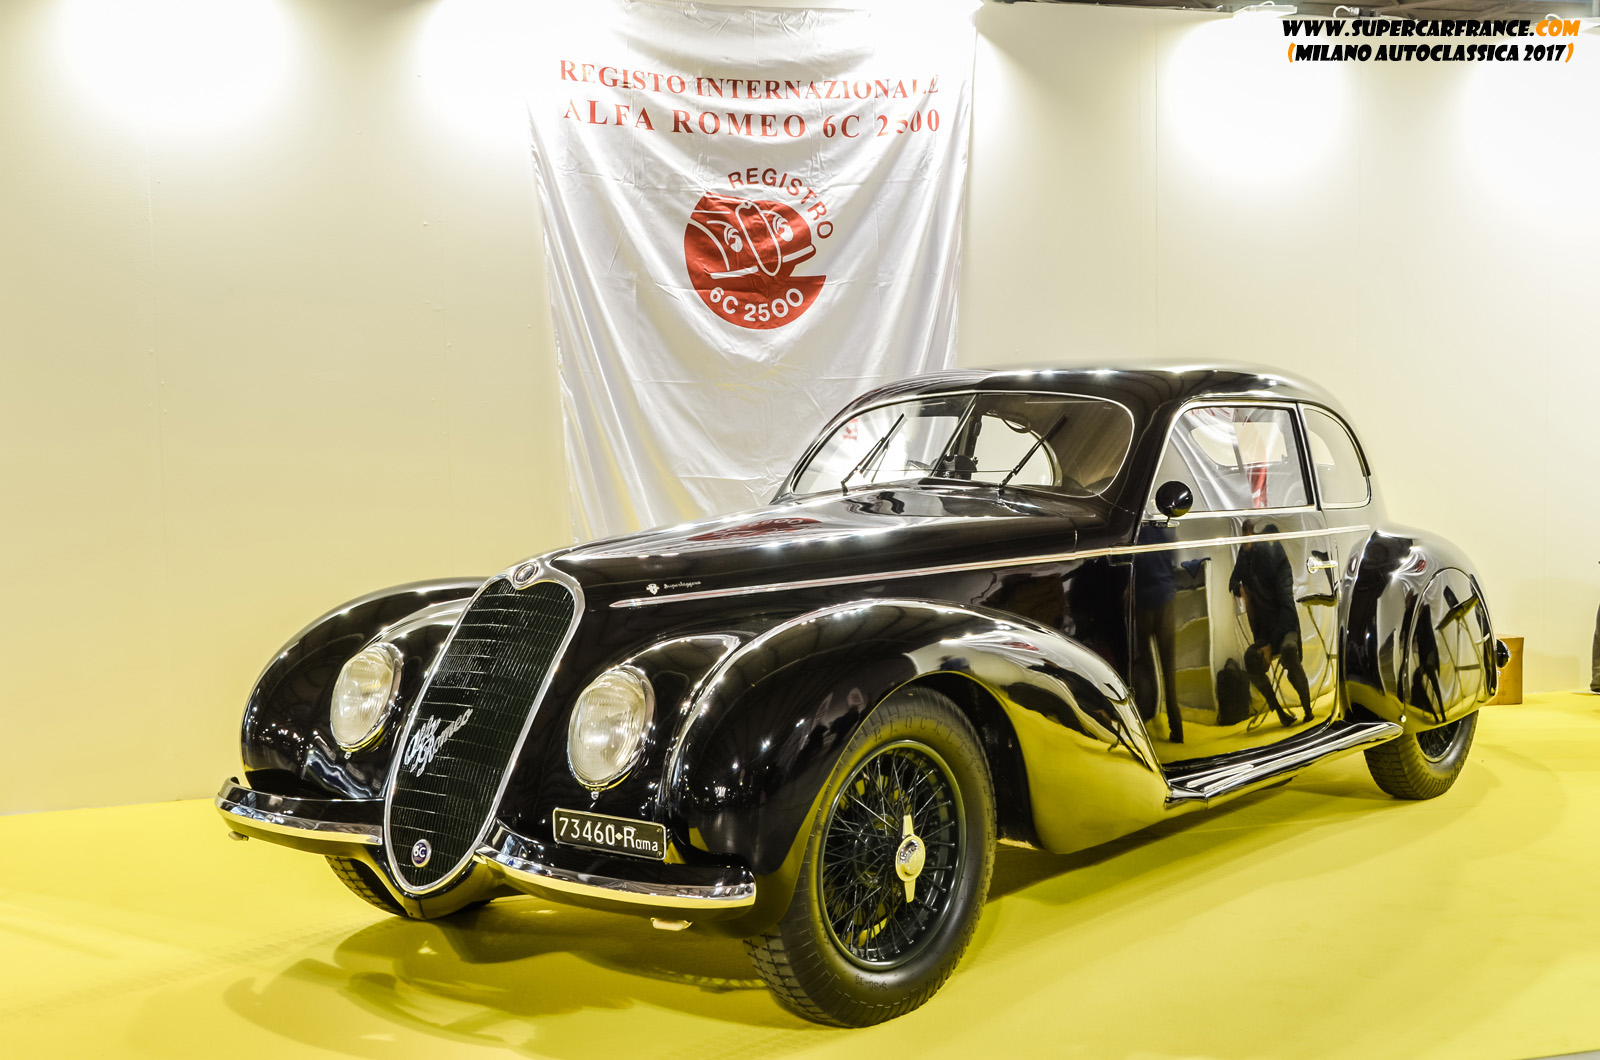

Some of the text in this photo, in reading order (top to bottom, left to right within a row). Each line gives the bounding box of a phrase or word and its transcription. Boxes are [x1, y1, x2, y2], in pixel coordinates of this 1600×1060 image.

[560, 60, 938, 99] REGISTO INTERNAZIONALE
[563, 99, 655, 131] ALFA
[671, 109, 806, 138] ROMEO
[822, 114, 860, 138] 6C
[727, 167, 834, 239] REGISTRO
[709, 286, 804, 322] 6C 2500
[404, 714, 442, 765] Alfa
[410, 708, 473, 777] Romeo
[413, 845, 426, 858] 6C
